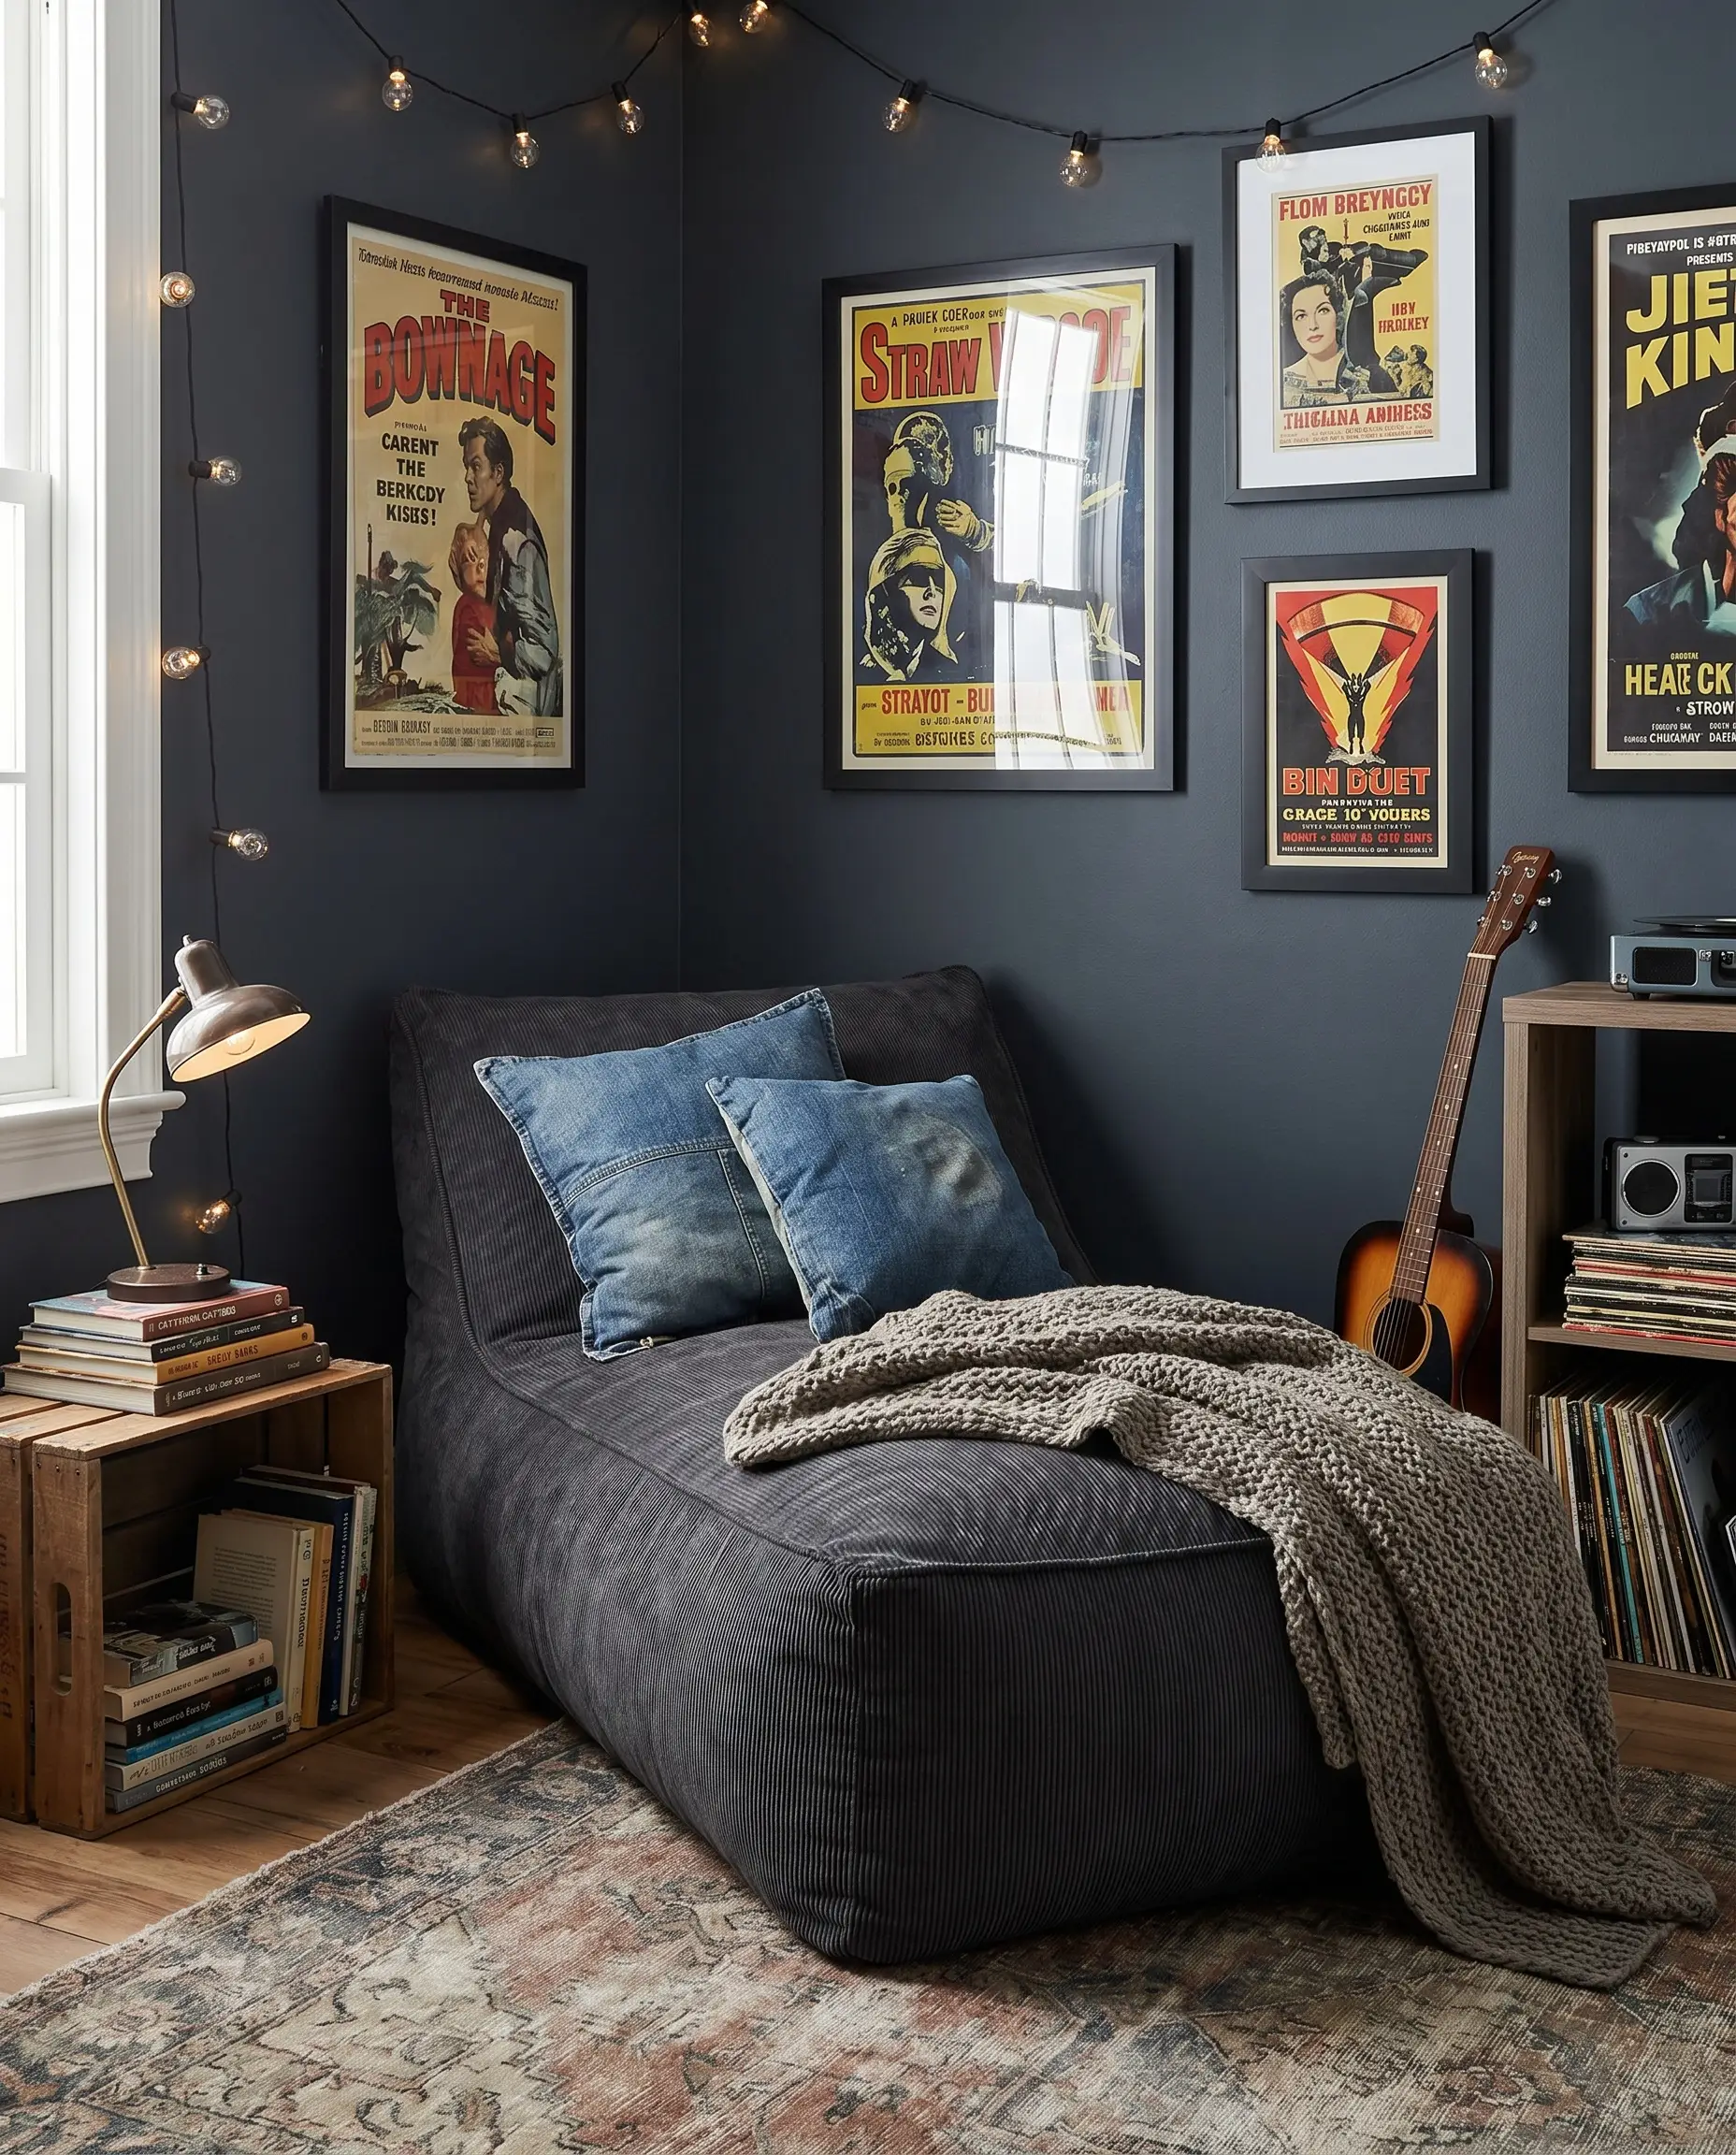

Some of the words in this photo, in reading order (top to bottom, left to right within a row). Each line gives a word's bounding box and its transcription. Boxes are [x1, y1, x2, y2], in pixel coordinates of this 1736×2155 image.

[1280, 196, 1327, 221] FLOM
[1694, 237, 1704, 249] IS
[440, 288, 490, 323] THE
[1626, 268, 1736, 334] JIE
[890, 317, 898, 327] A
[382, 432, 440, 457] CARENT
[396, 457, 426, 478] THE
[881, 688, 950, 715] STRAYOT
[1282, 767, 1338, 795] BIN
